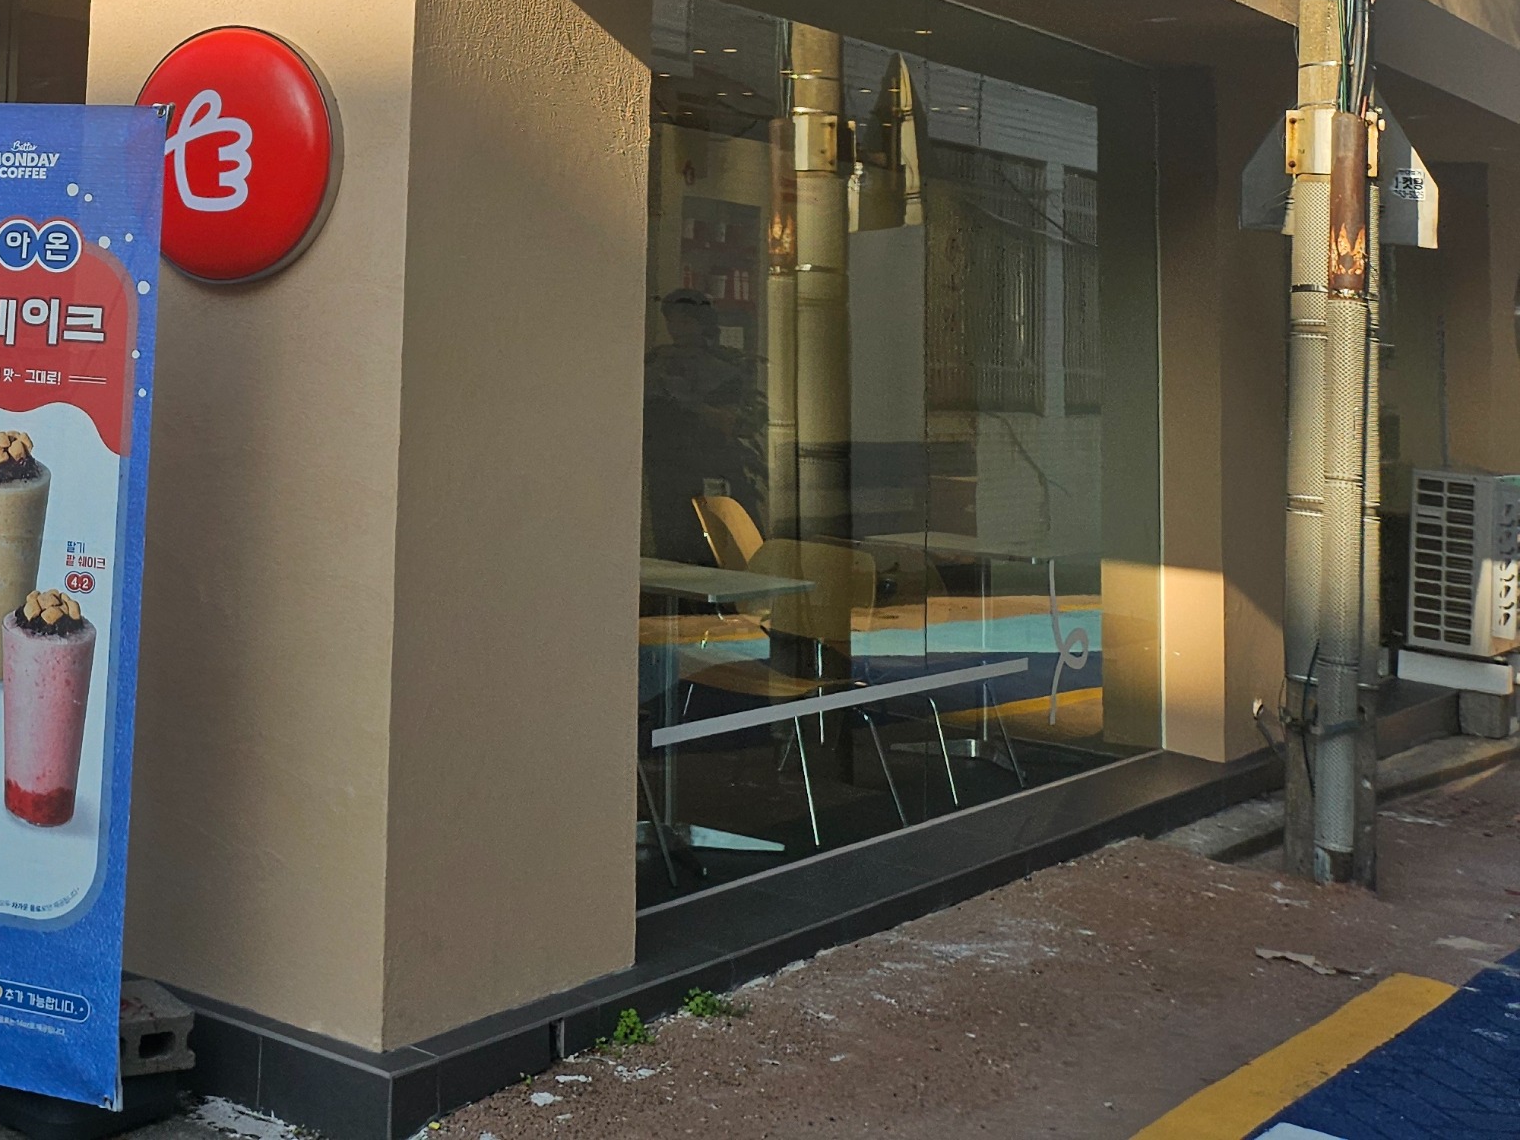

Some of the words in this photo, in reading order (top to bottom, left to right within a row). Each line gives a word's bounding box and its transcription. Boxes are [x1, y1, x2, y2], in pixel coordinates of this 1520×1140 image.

[11, 140, 38, 152] Better
[24, 370, 61, 385] 그대로!
[66, 540, 86, 554] 딸기
[78, 555, 106, 570] 쉐이크
[70, 576, 89, 590] 4.2
[5, 988, 24, 1003] 추가
[27, 992, 78, 1015] 가능합니다.
